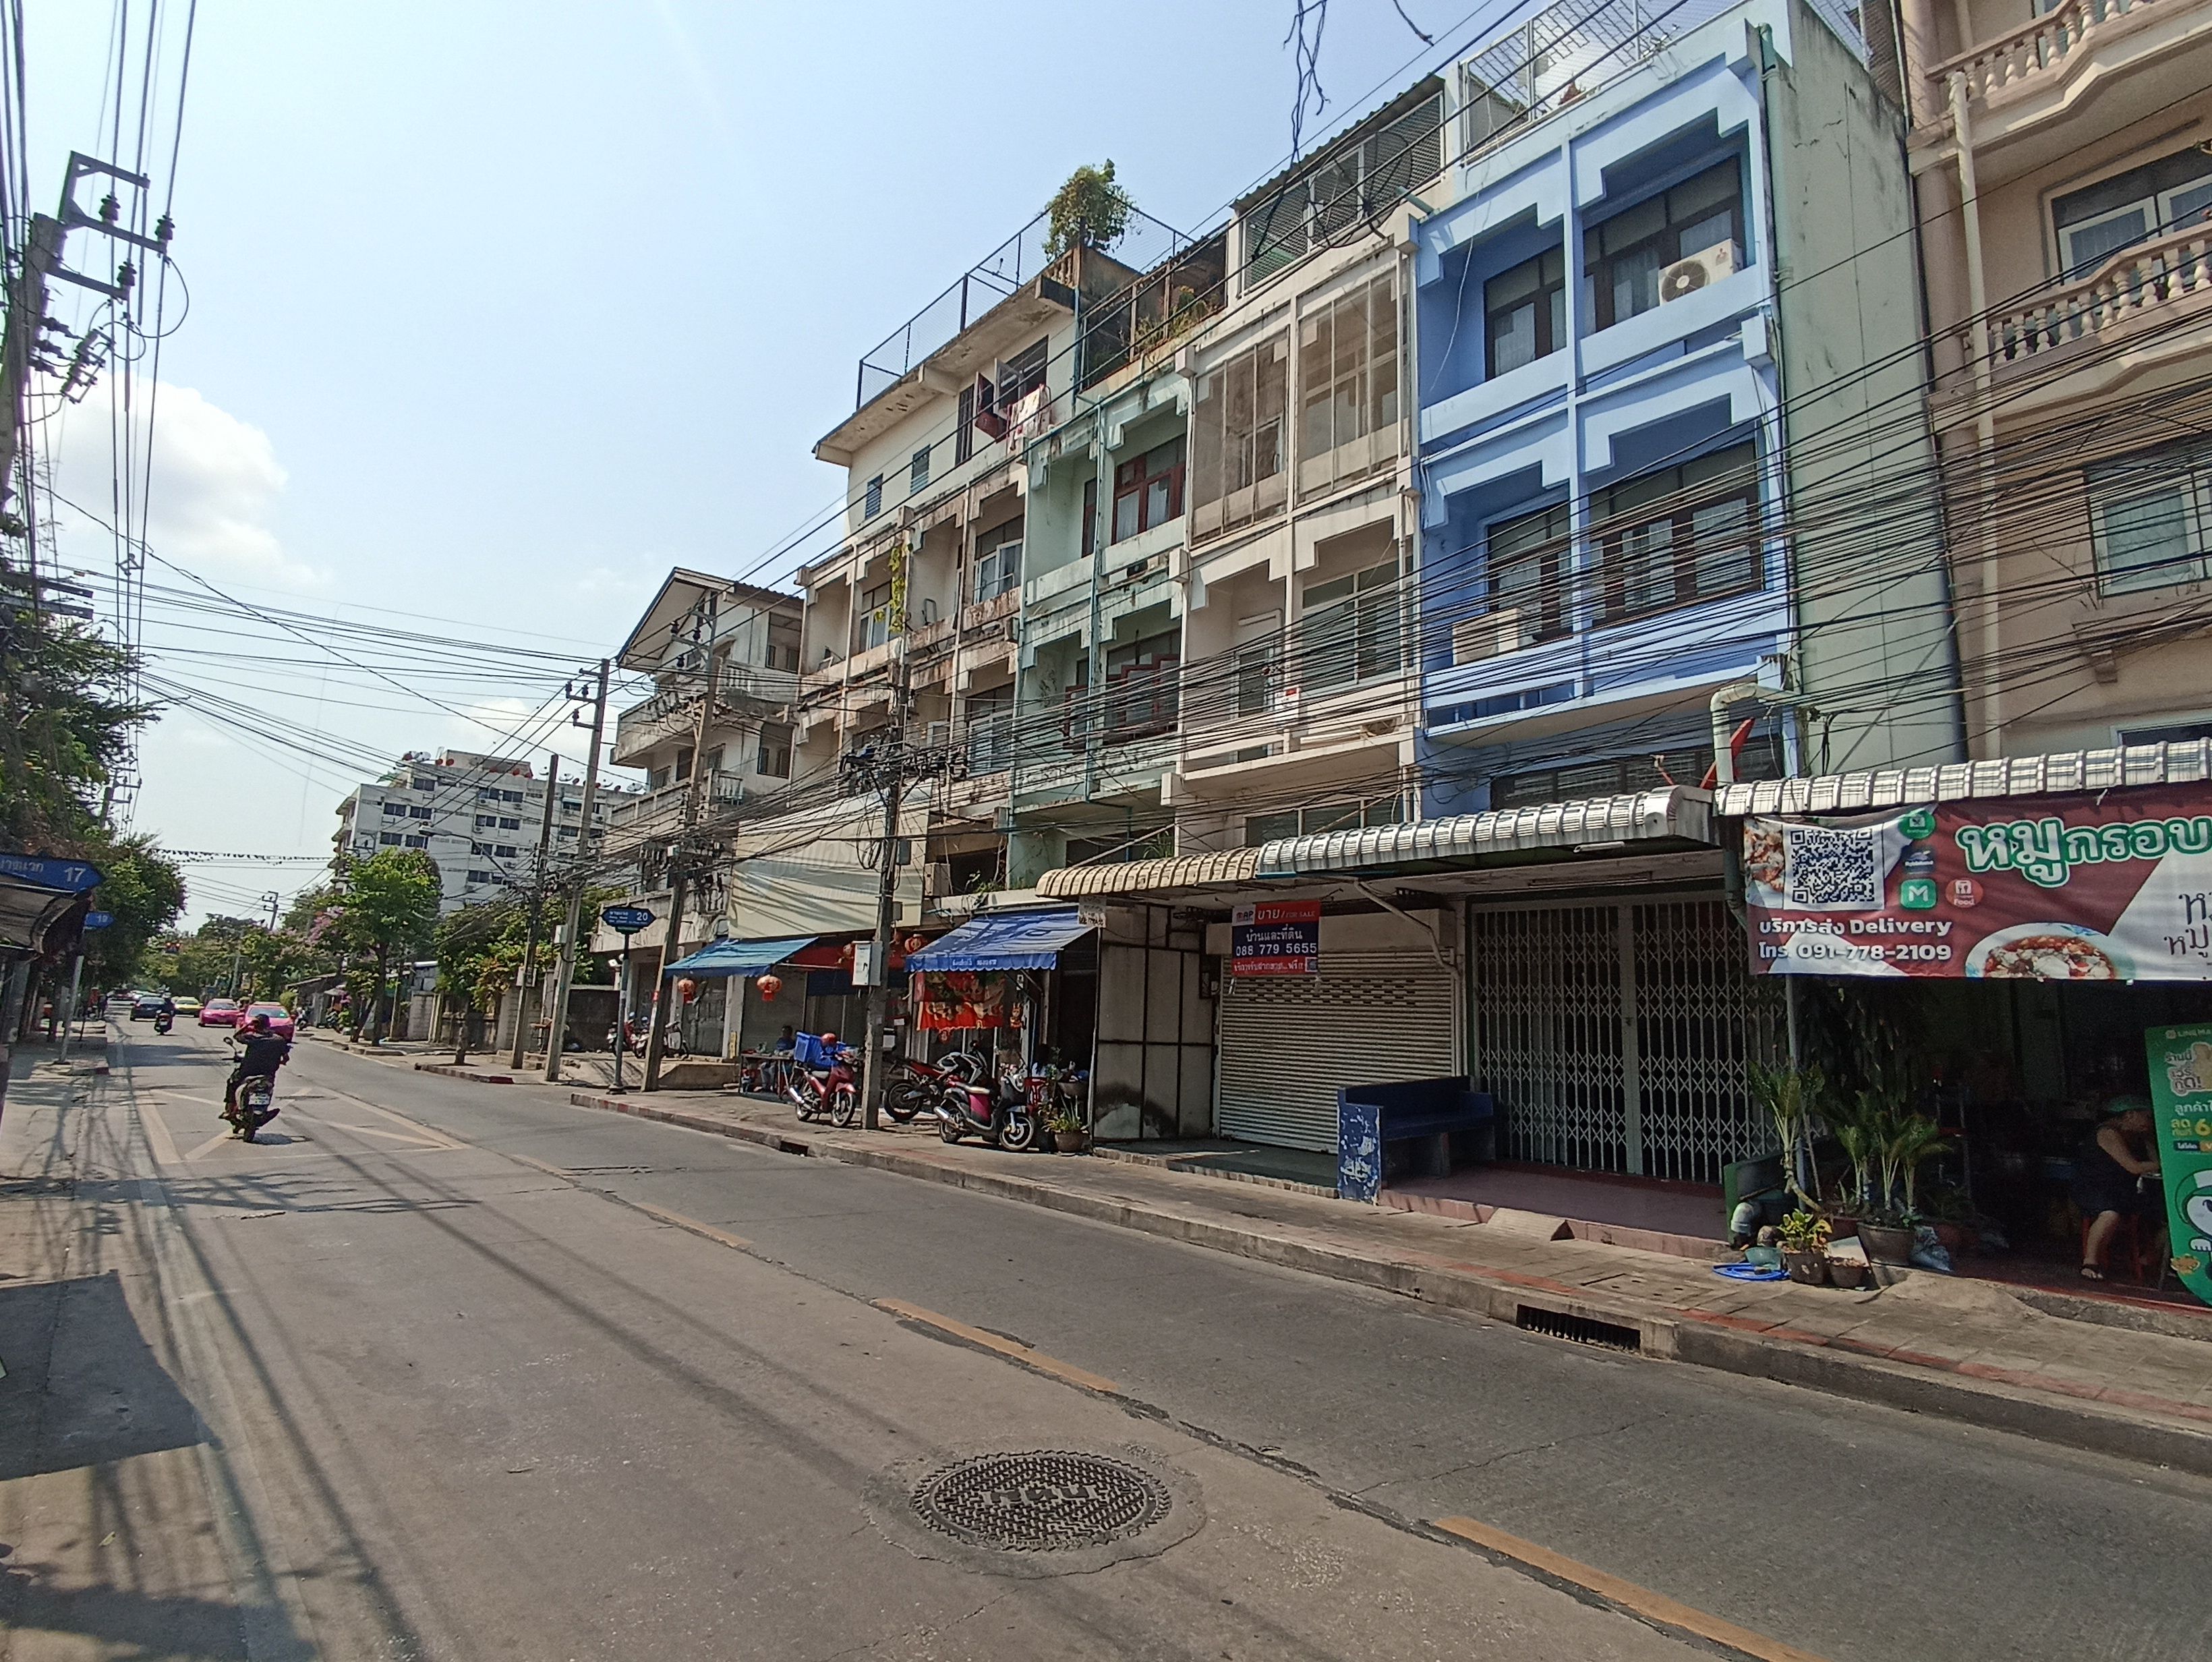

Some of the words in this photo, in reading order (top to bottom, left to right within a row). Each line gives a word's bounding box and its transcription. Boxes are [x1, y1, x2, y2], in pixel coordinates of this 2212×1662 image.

[1959, 818, 2212, 885] หมูกรอบ
[64, 867, 86, 882] 17
[637, 912, 648, 921] 20
[1258, 909, 1280, 920] ขาย
[1246, 924, 1303, 942] บ้านและที่ดิน
[1759, 917, 1845, 935] บริการส่ง
[1850, 918, 1952, 936] Delivery
[1235, 946, 1254, 956] 088
[1259, 944, 1280, 955] 779
[1286, 943, 1317, 954] 5655
[1797, 944, 1952, 961] 091-778-2109
